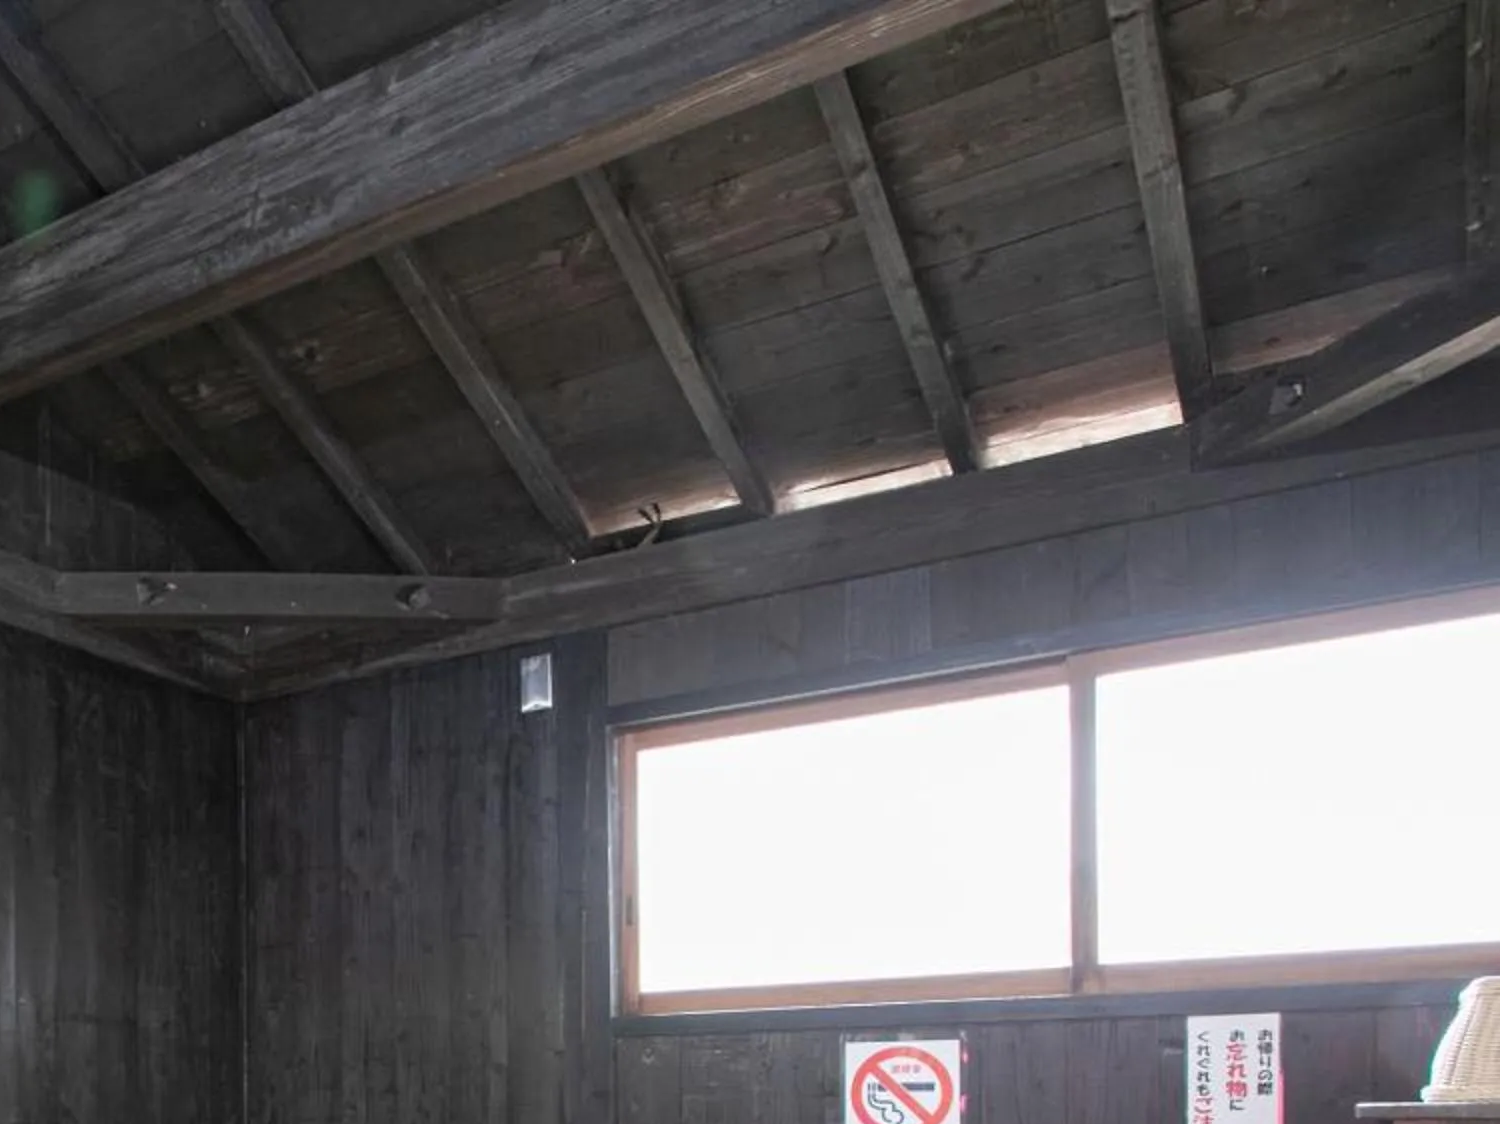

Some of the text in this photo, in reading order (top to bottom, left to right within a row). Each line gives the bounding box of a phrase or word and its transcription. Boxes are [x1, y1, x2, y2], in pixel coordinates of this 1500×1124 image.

[1226, 1029, 1248, 1111] お忘れ物に
